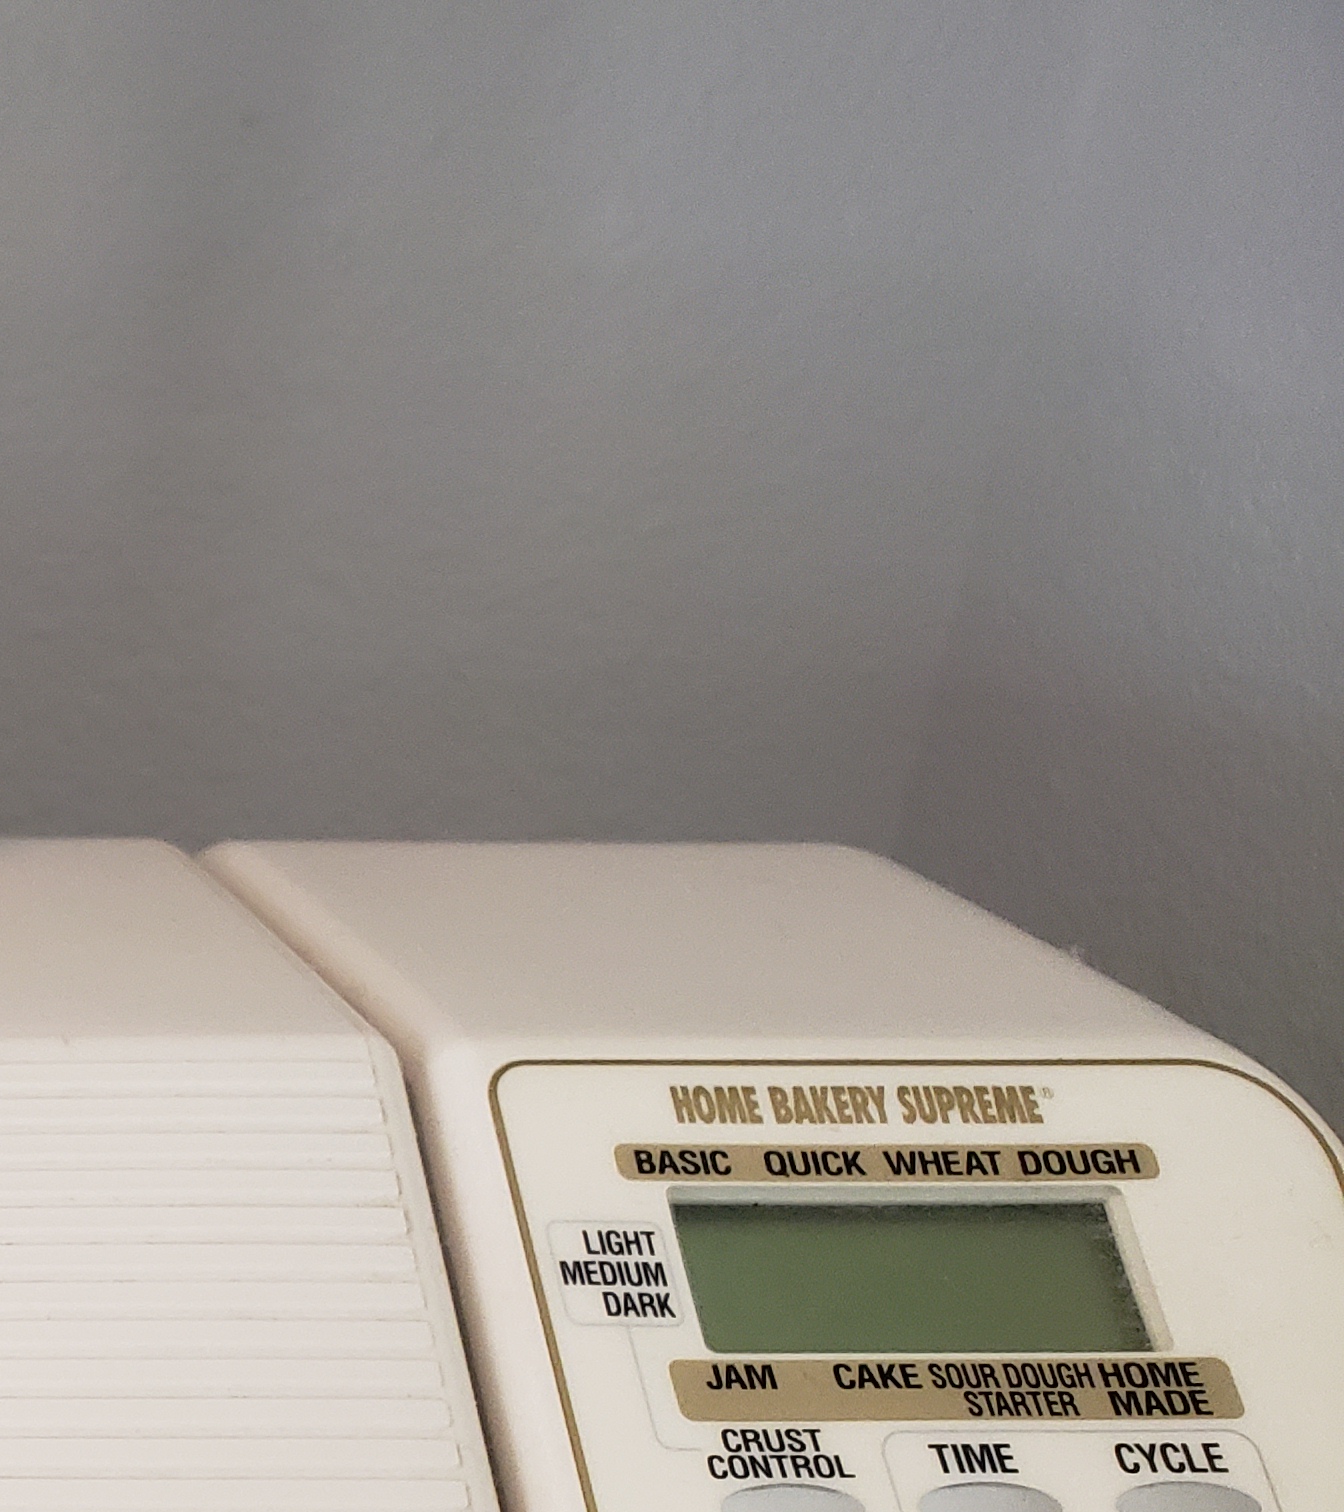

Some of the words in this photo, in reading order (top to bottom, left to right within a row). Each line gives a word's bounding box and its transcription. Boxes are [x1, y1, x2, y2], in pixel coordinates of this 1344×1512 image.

[669, 1085, 764, 1124] HOME
[767, 1085, 888, 1125] BAKERY
[633, 1149, 732, 1177] BASIC
[764, 1149, 868, 1178] QUICK
[883, 1150, 1003, 1177] WHEAT
[1017, 1150, 1142, 1176] DOUGH
[581, 1230, 656, 1257] LIGHT
[559, 1261, 669, 1288] MEDIUM
[602, 1292, 677, 1319] DARK
[706, 1364, 779, 1391] JAM
[832, 1363, 924, 1391] CAKE
[930, 1363, 999, 1390] SOUR
[1003, 1362, 1096, 1390] DOUGH
[1098, 1361, 1205, 1389] HOME
[963, 1391, 1080, 1418] STARTER
[1108, 1389, 1215, 1417] MADE
[720, 1428, 823, 1454] CRUST
[707, 1454, 856, 1480] CONTROL
[928, 1443, 1019, 1474] TIME
[1113, 1442, 1229, 1474] CYCLE
